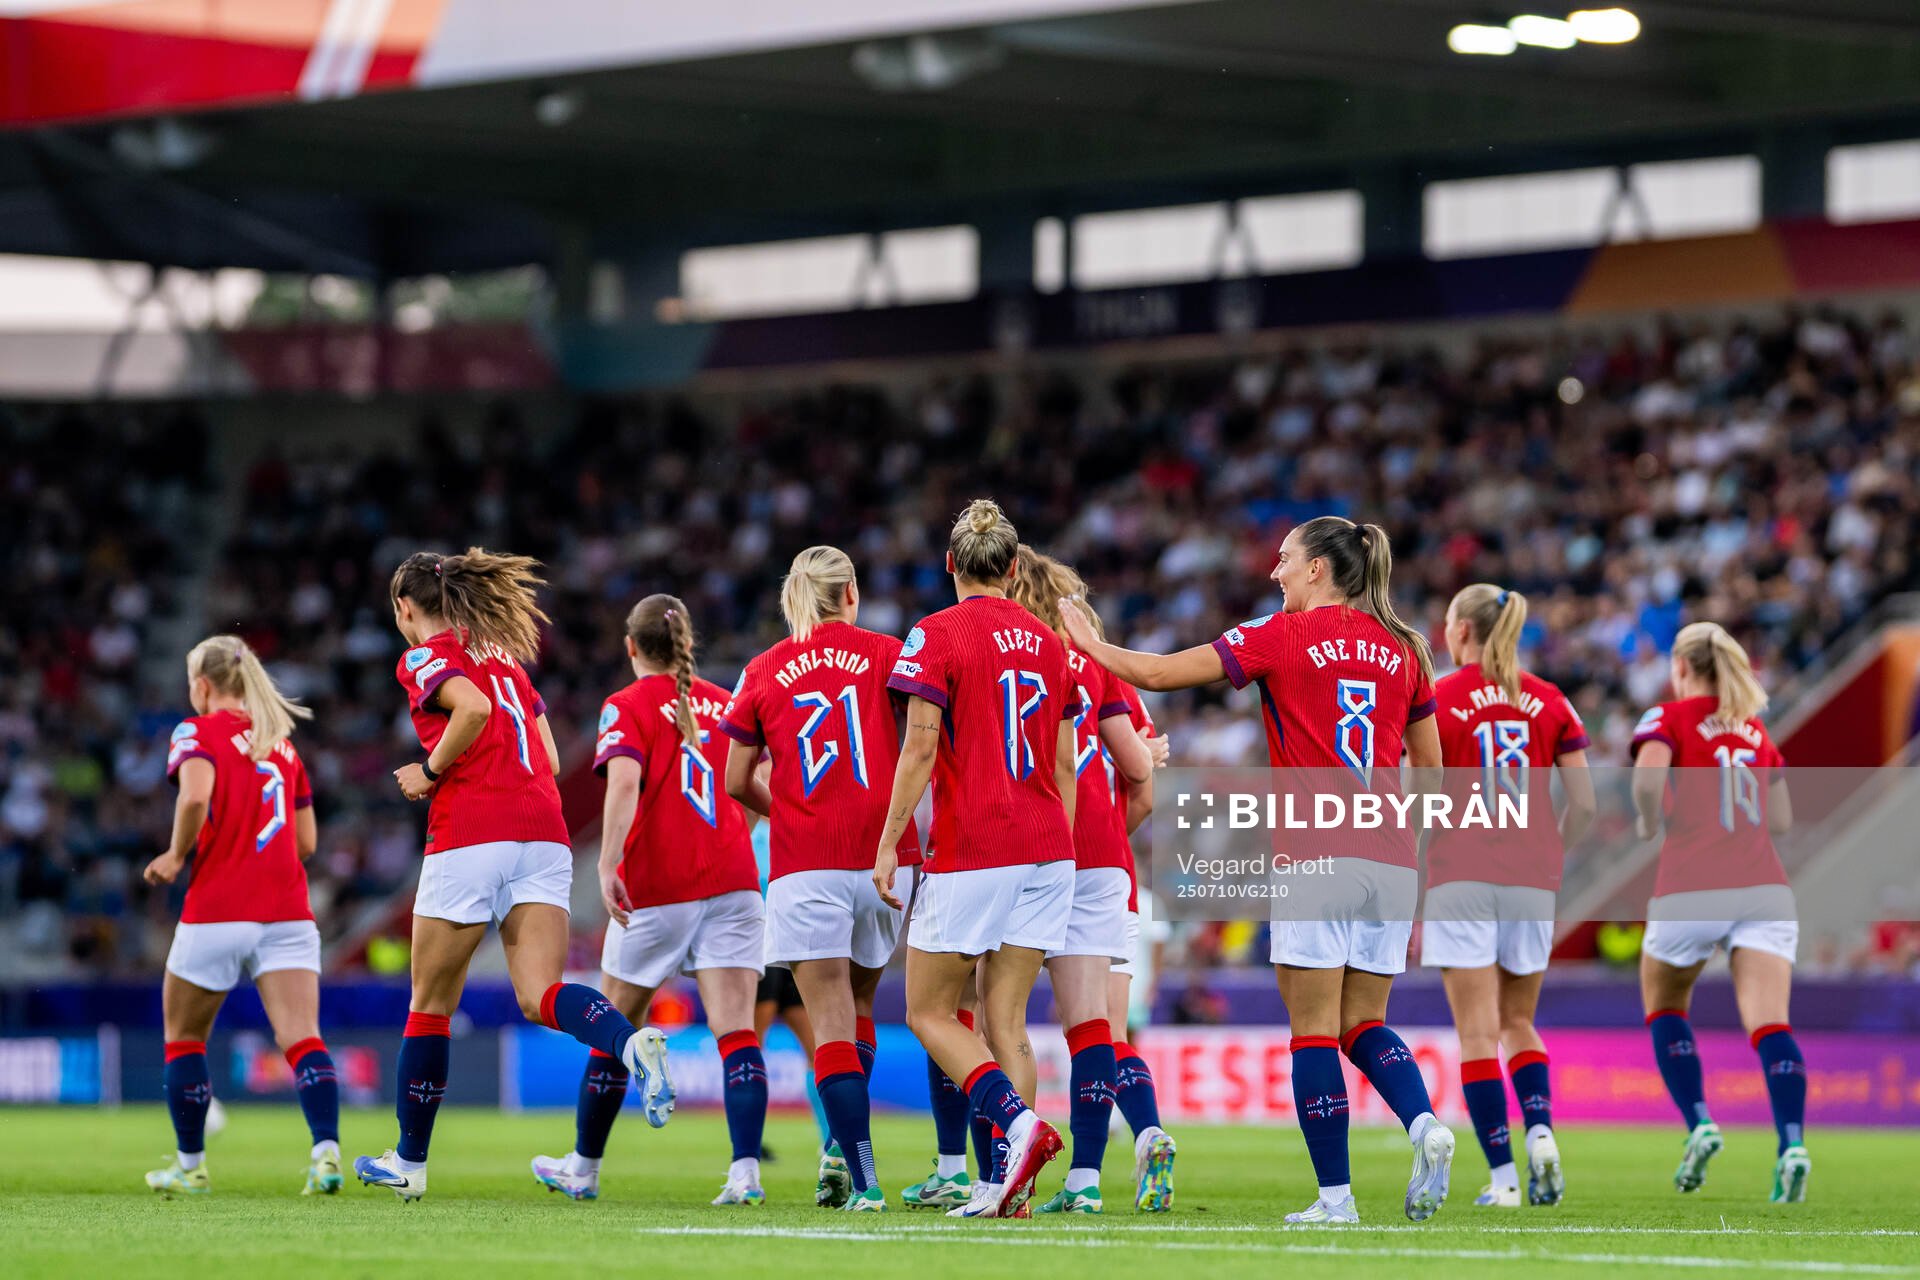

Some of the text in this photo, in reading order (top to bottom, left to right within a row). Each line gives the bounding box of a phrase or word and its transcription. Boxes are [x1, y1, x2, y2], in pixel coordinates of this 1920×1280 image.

[775, 647, 870, 688] NAALSUND
[1356, 639, 1402, 676] RISA
[1469, 684, 1545, 719] MAAUM
[489, 673, 534, 775] 4
[792, 685, 870, 799] 21
[1335, 678, 1377, 792] 8
[1472, 720, 1530, 817] 18
[256, 760, 287, 853] 3
[681, 729, 717, 829] 6
[1713, 745, 1761, 833] 16
